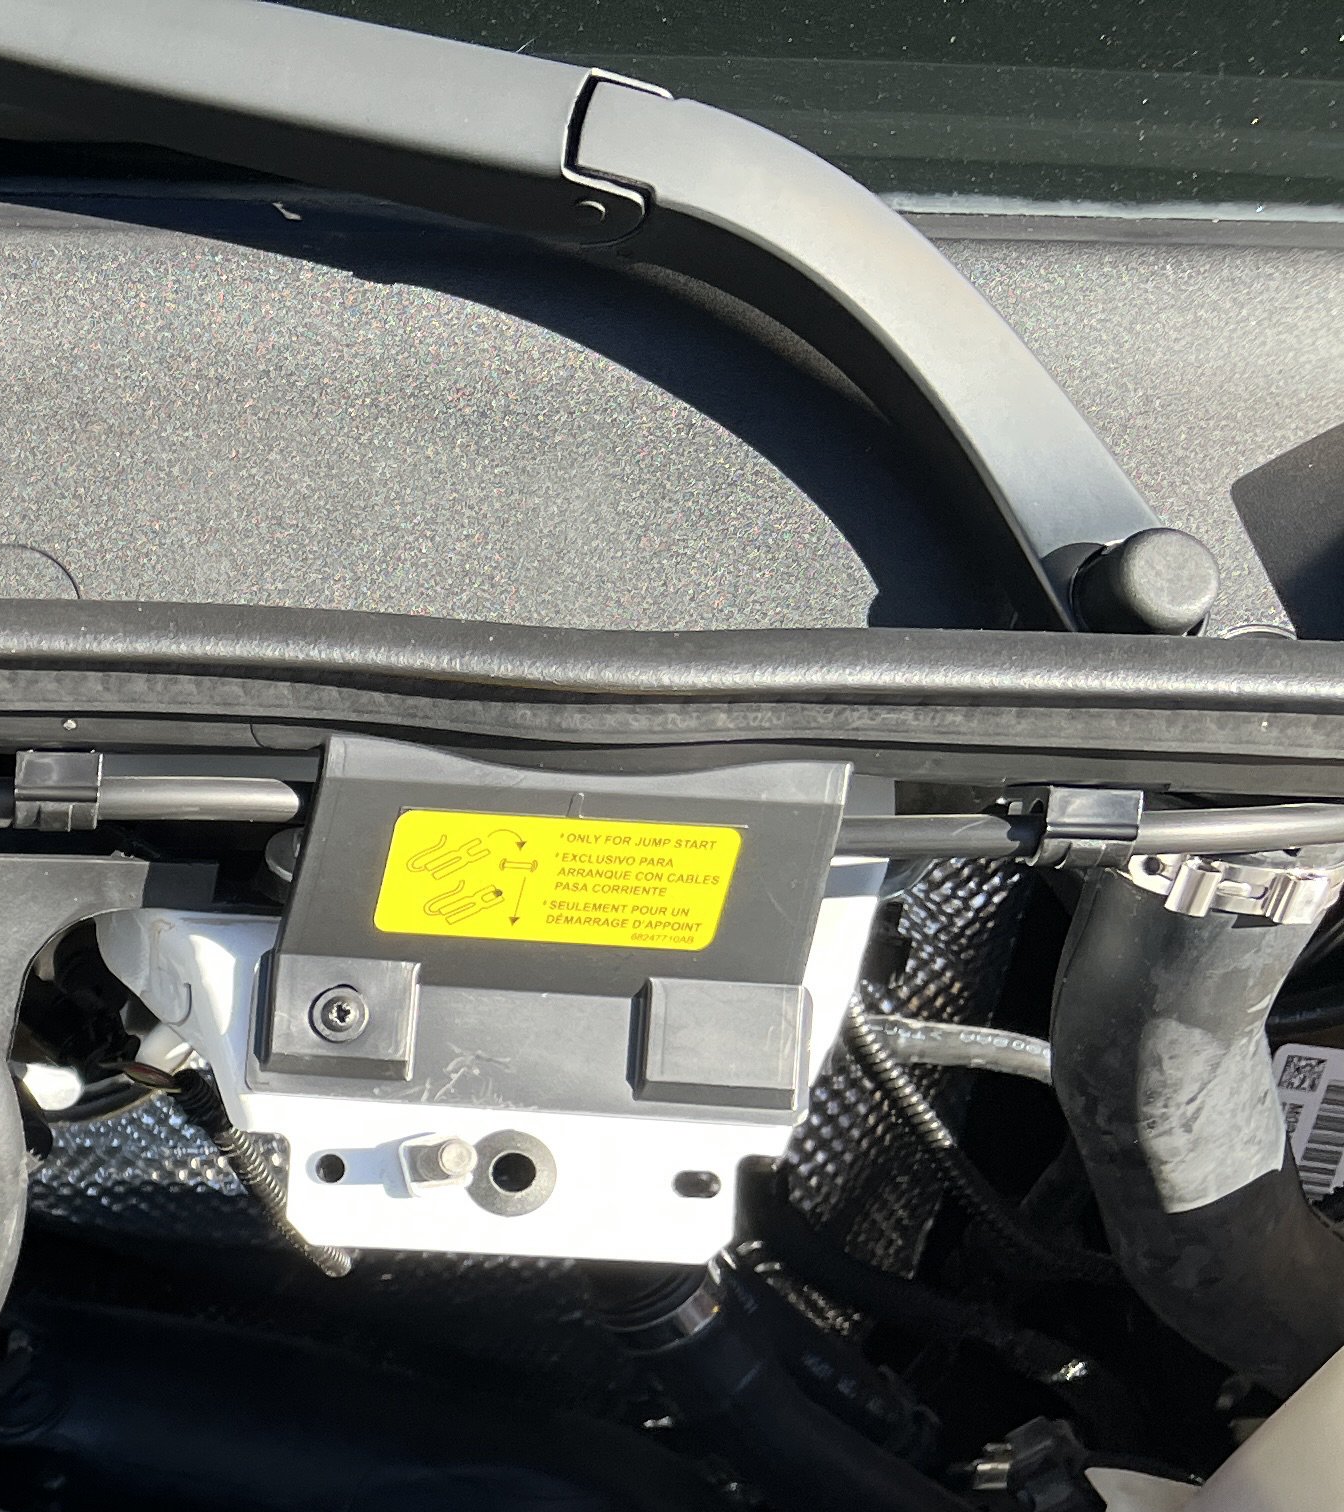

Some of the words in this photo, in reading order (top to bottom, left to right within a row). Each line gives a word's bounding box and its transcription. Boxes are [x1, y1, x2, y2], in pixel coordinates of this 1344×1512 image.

[566, 833, 601, 844] ONLY
[604, 835, 632, 846] FOR
[635, 837, 671, 848] JUMP
[673, 839, 717, 850] START
[561, 853, 636, 866] EXCLUSIVO
[639, 858, 674, 868] PARA
[557, 867, 632, 881] ARRANQUE
[635, 872, 663, 882] CON
[667, 873, 720, 885] CABLES
[554, 882, 588, 892] PASA
[592, 884, 667, 897] CORRIENTE
[549, 900, 628, 914] SEULEMENT
[630, 905, 667, 916] POUR
[671, 907, 690, 917] UN
[546, 913, 629, 929] DÉMARRAGE
[632, 919, 702, 932] D'APPOINT
